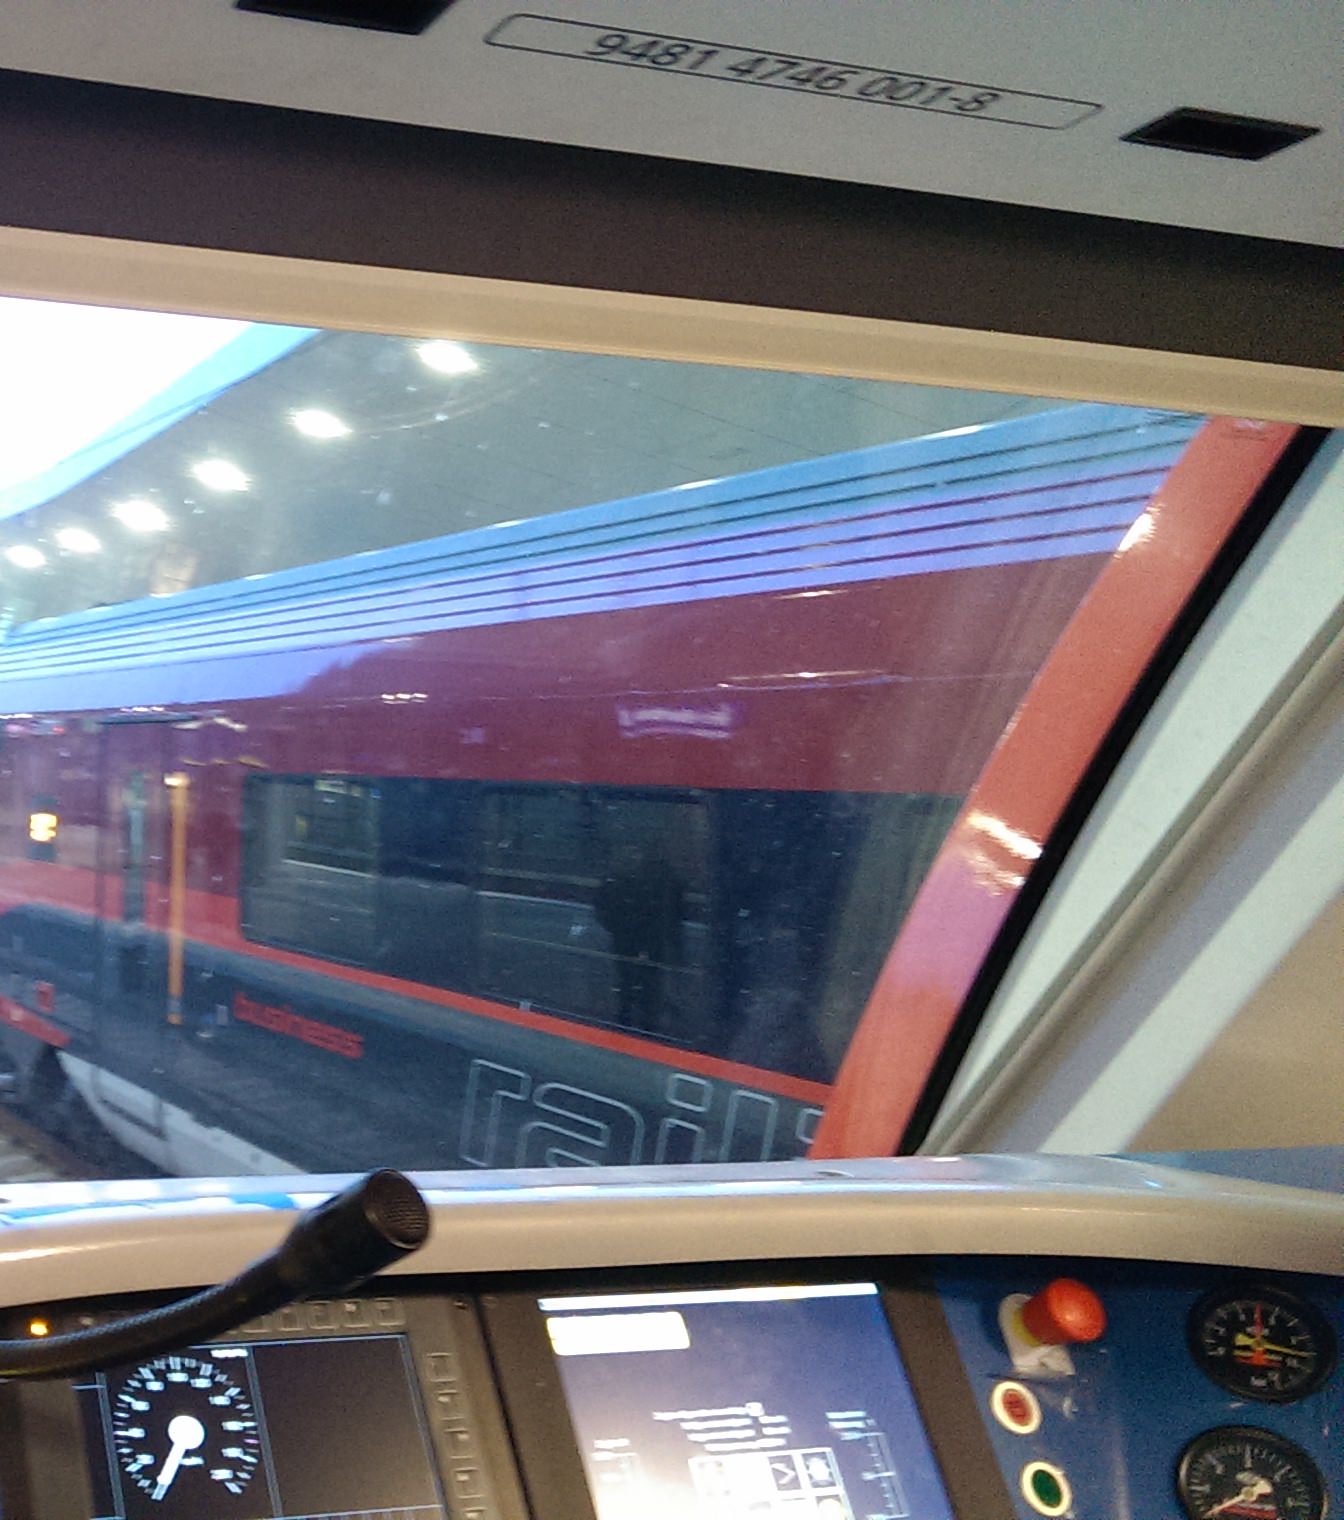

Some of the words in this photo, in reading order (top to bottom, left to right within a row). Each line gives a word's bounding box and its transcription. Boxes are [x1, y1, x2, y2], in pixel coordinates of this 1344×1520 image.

[584, 34, 719, 70] 9481
[726, 55, 860, 91] 4746
[857, 75, 1000, 113] 001-8
[234, 991, 365, 1061] business
[460, 1058, 825, 1168] rail
